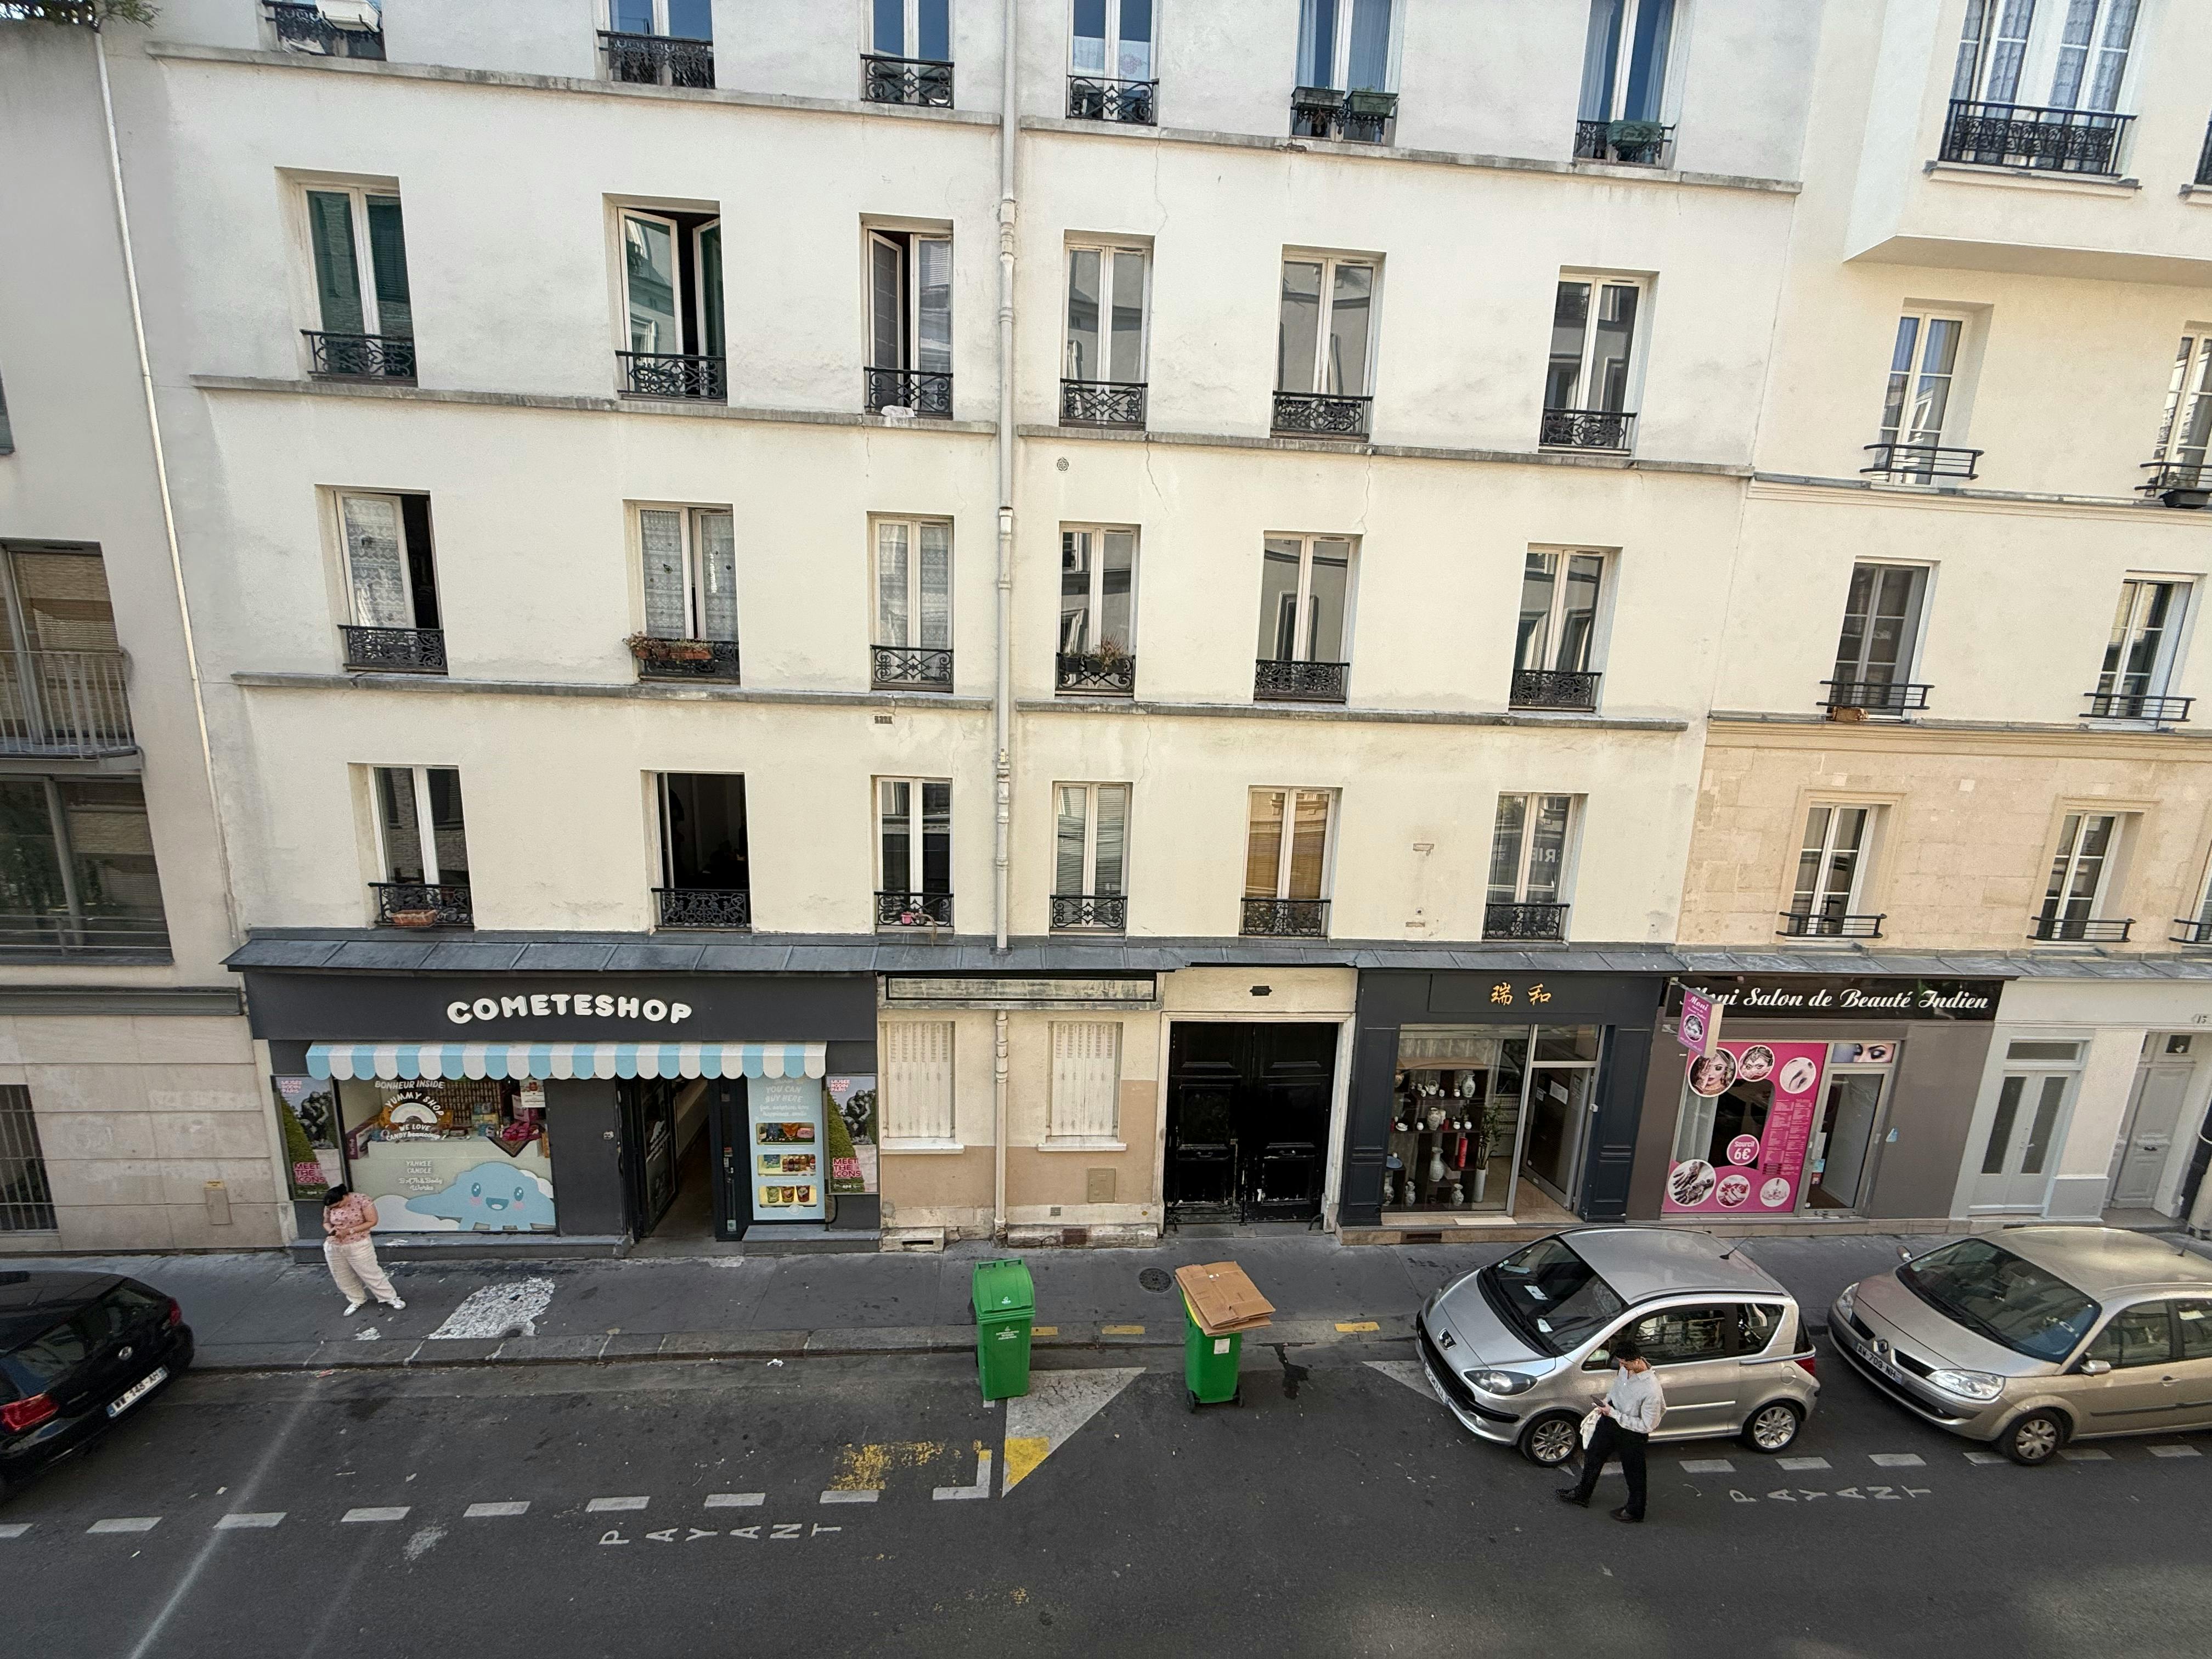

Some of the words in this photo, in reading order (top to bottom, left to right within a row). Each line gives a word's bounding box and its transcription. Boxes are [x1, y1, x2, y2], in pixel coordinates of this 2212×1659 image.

[1491, 983, 1551, 1006] 瑞和
[1689, 996, 1709, 1011] Moni
[1743, 988, 1803, 1007] Salon
[1808, 989, 1833, 1007] de
[1839, 989, 1913, 1008] Beauté
[1918, 990, 1989, 1008] Indien
[447, 994, 692, 1024] COMETESHOP
[375, 1081, 415, 1089] BONHEUR
[416, 1080, 445, 1089] INSIDE
[385, 1092, 422, 1108] YUMMY
[423, 1096, 444, 1116] SHOP
[386, 1133, 407, 1141] CANDY
[1734, 1148, 1752, 1160] 6€
[598, 1523, 842, 1545] PAYANT
